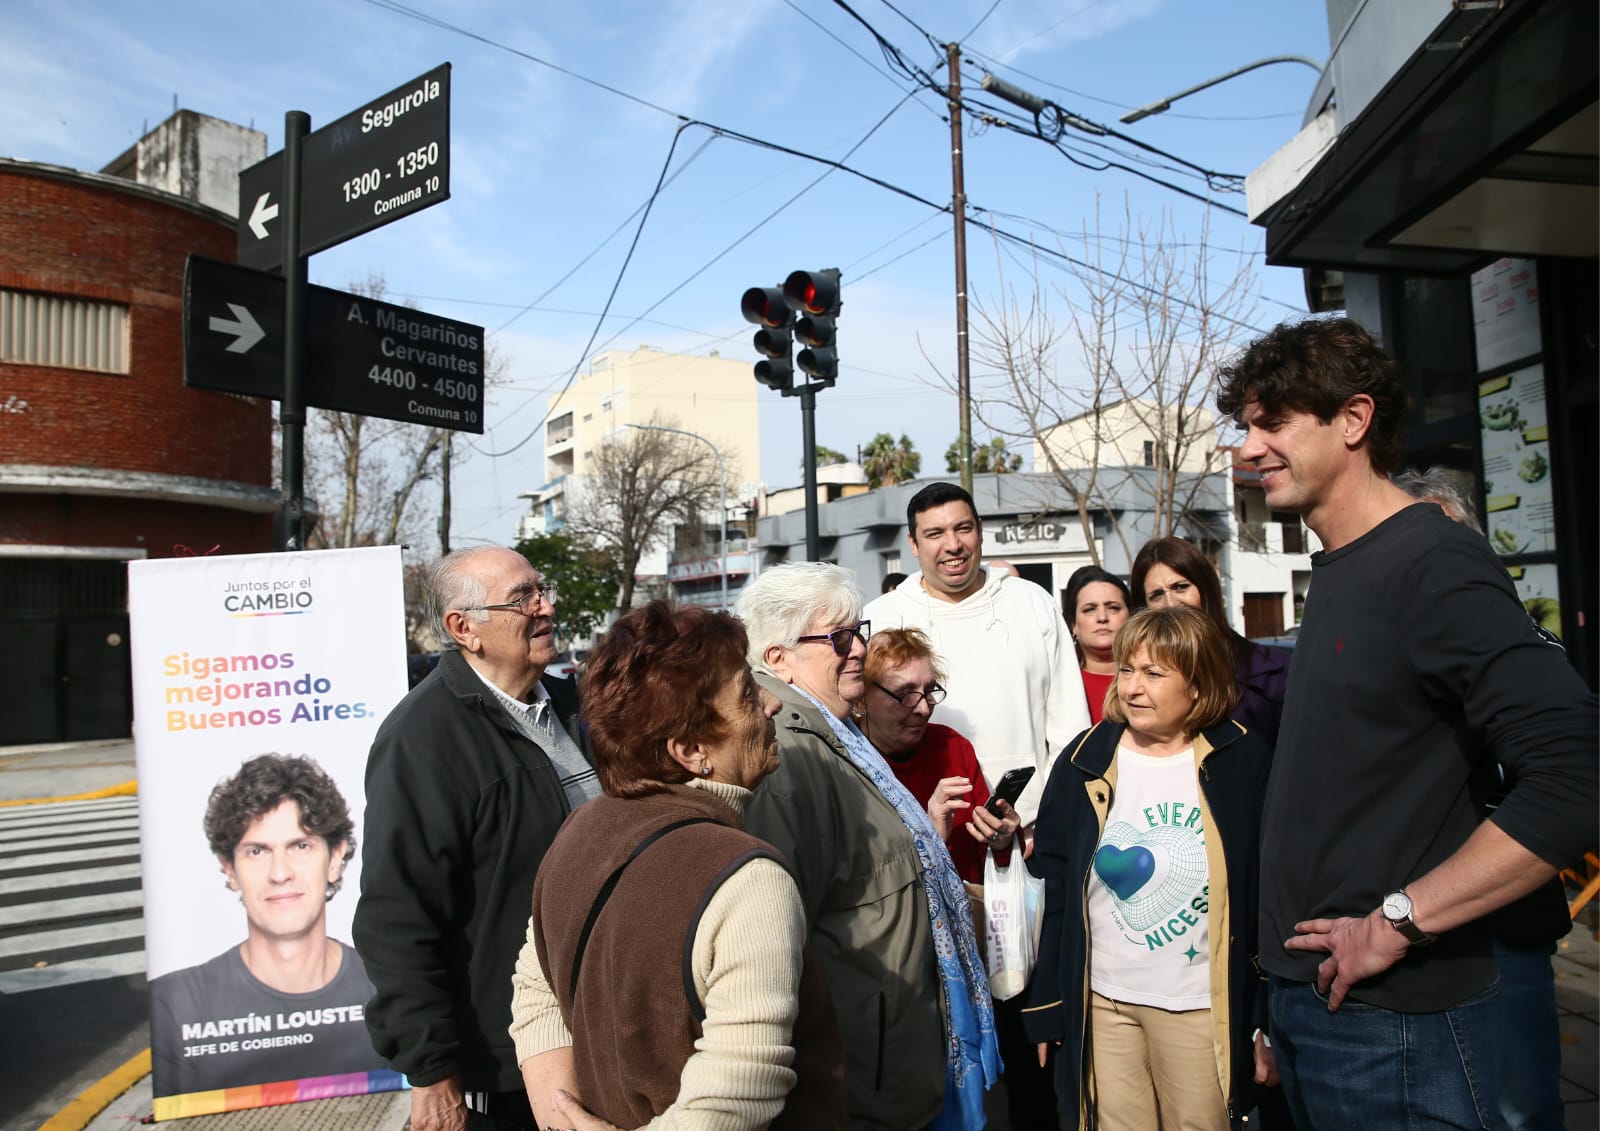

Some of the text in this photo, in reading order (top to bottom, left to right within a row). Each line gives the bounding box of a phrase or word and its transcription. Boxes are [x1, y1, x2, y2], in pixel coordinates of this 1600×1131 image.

[361, 79, 440, 134] Segurola
[343, 168, 381, 203] 1300
[397, 142, 439, 178] 1350
[374, 176, 440, 215] Comuna 10
[347, 302, 479, 350] A. Magariños
[381, 336, 478, 375] Cervantes
[368, 364, 416, 391] 4400
[433, 378, 478, 402] 4500
[407, 400, 478, 423] Comuna 10
[224, 577, 312, 593] Juntos por el
[224, 591, 313, 612] CAMBIO
[163, 652, 295, 680] Sigamos
[165, 673, 332, 706] mejorando
[167, 698, 375, 732] Buenos Aires.
[182, 1004, 365, 1041] MARTÍN LOUSTE
[184, 1032, 314, 1058] JEFE DE GOBIERNO
